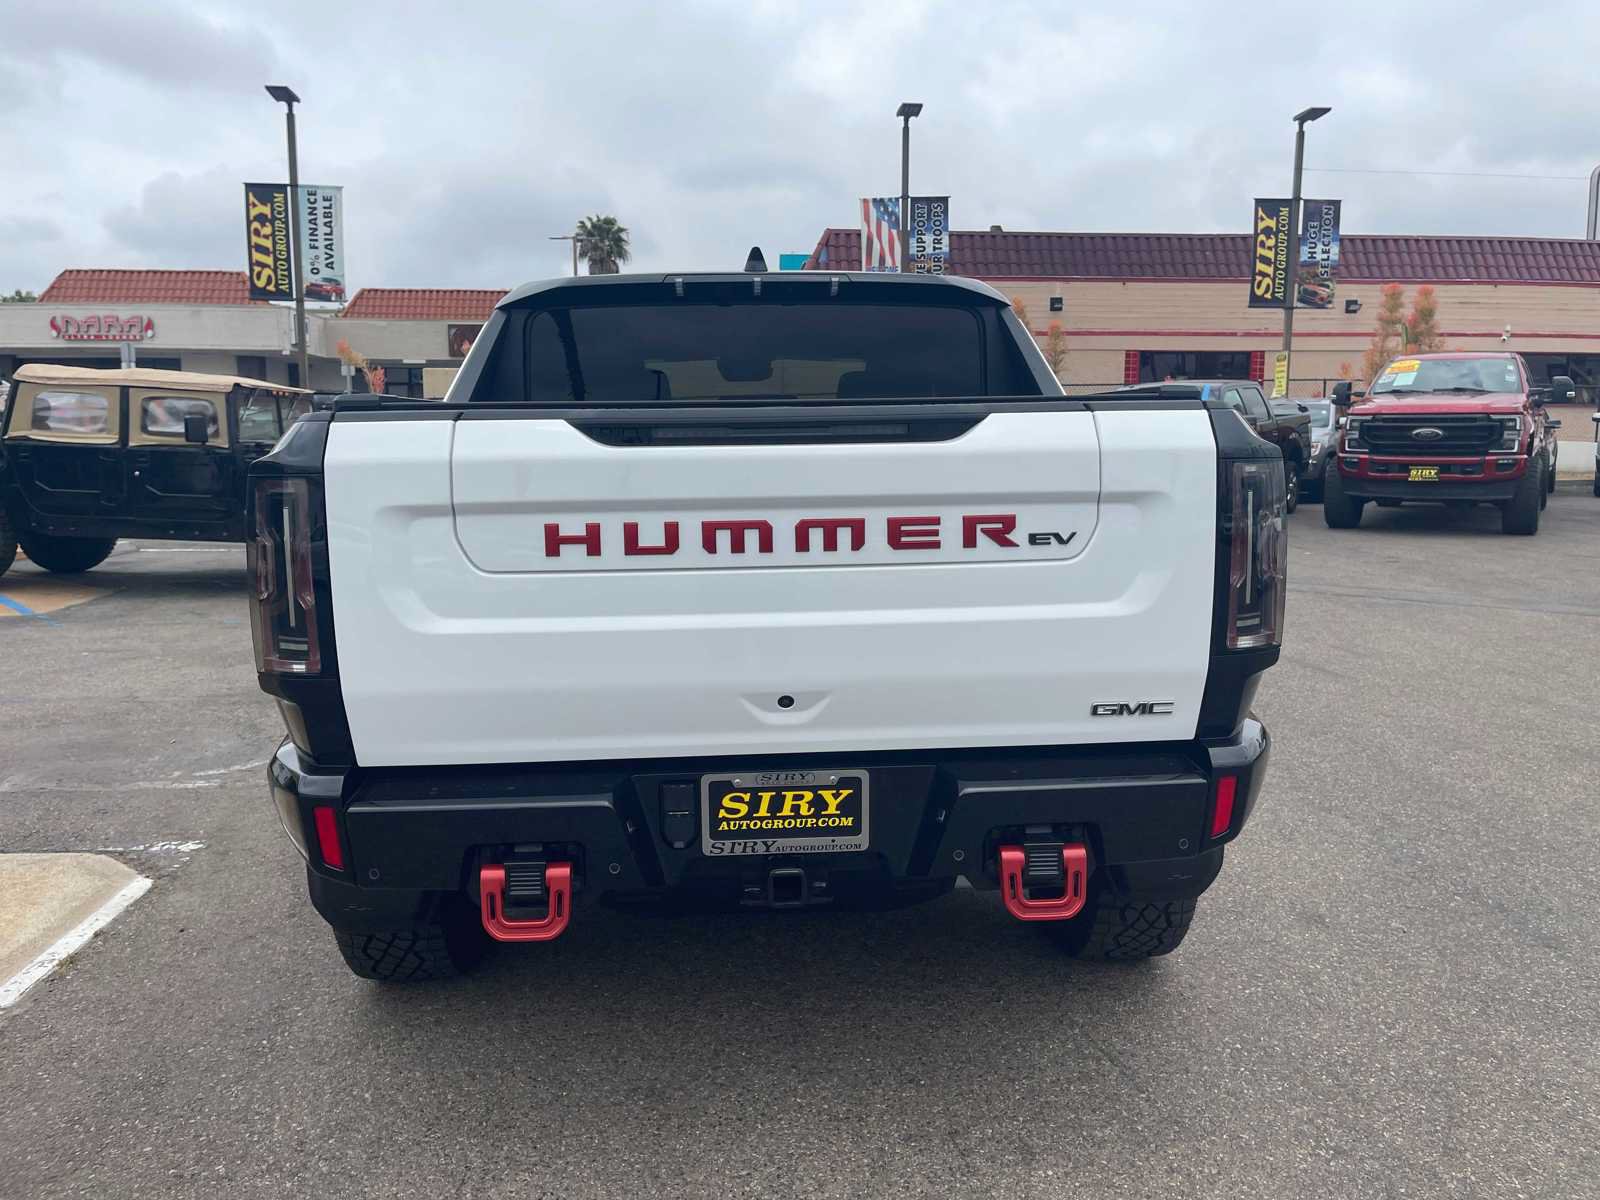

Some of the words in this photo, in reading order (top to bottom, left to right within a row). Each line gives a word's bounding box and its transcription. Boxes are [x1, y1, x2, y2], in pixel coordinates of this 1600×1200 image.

[307, 189, 319, 249] FINANCE
[322, 195, 334, 270] AVAILABLE
[915, 204, 926, 259] SUPPORT
[932, 203, 943, 252] TROOPS
[248, 192, 276, 292] SIRY
[1254, 207, 1276, 299] SIRY
[1307, 222, 1319, 260] HUGE
[1320, 206, 1334, 278] SELECTION
[277, 261, 289, 292] AUTO
[310, 255, 320, 275] 0%
[932, 255, 943, 275] UR
[1274, 271, 1285, 300] AUTO
[544, 514, 1020, 557] HUMMER
[1028, 532, 1077, 546] EV
[1091, 702, 1174, 716] GMC
[760, 772, 809, 781] SIRY
[718, 789, 854, 819] SIRY
[718, 817, 854, 831] AUTOGROUP.COM
[709, 840, 779, 855] SIRY
[776, 843, 862, 852] AUTOGROUP.COM
